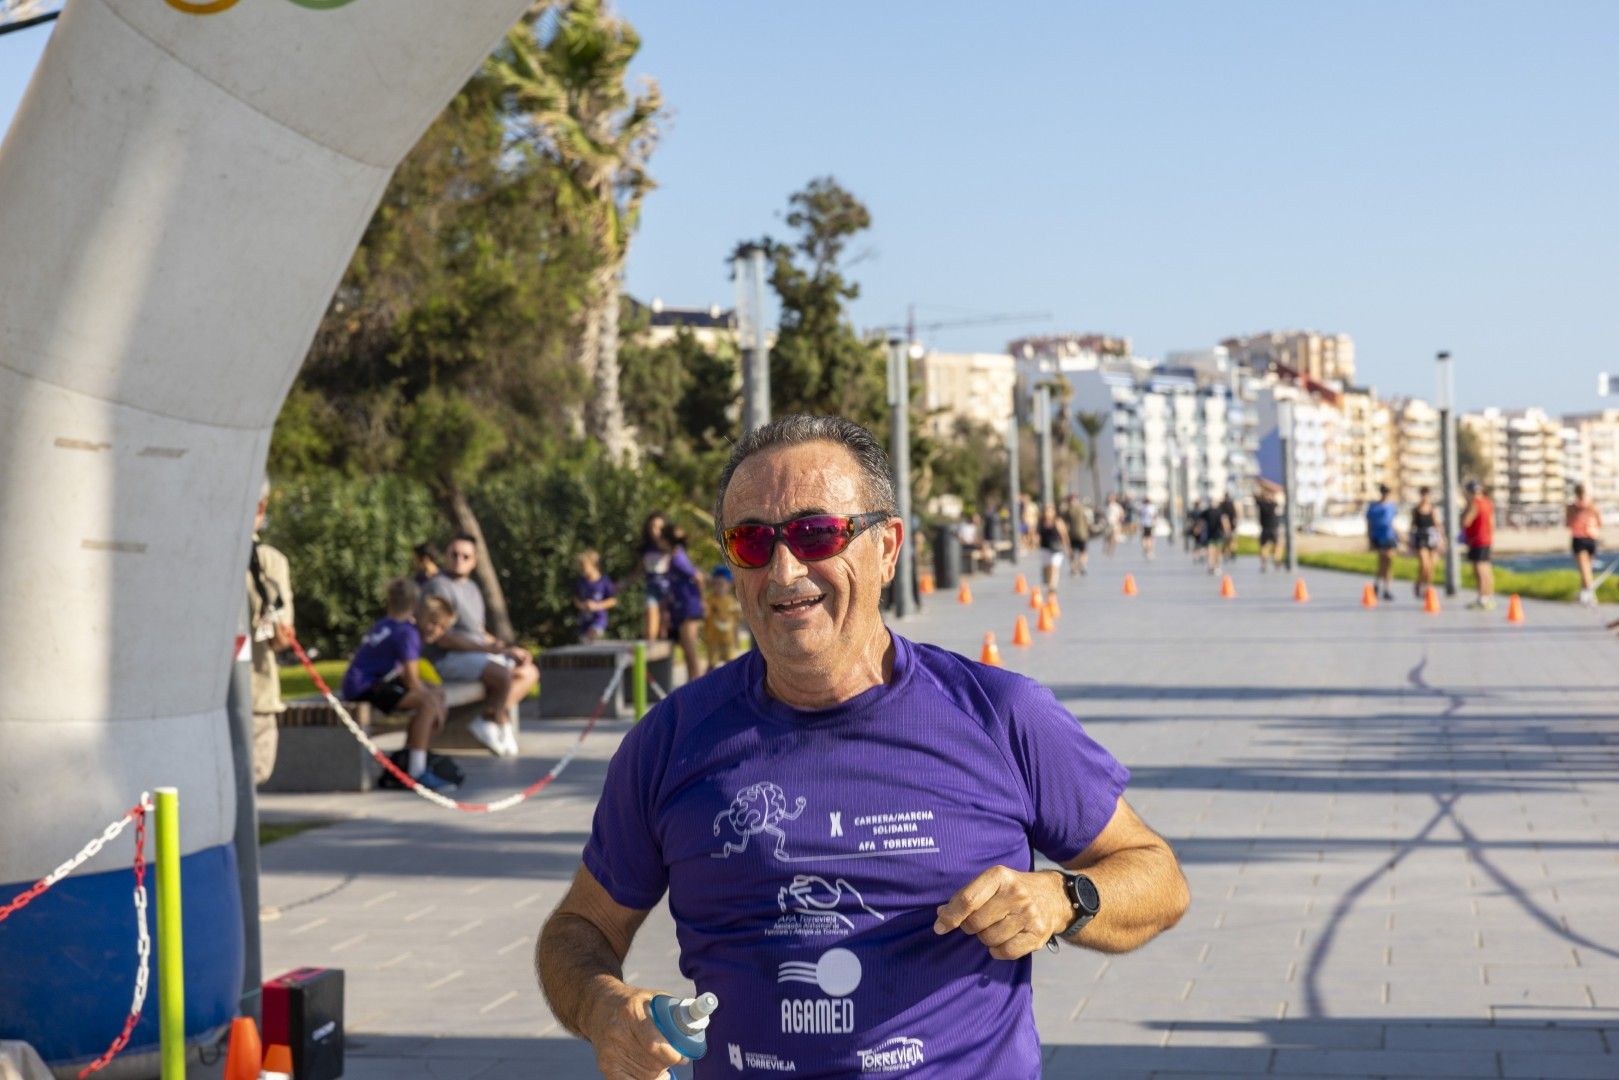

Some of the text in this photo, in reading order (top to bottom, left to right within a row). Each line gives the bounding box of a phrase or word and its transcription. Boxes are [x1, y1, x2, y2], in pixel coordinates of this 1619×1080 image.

[854, 810, 934, 826] CARRERA/MARCHA
[873, 822, 918, 836] SOLIDARIA
[858, 836, 935, 852] AFA TORREVIEJA
[781, 998, 854, 1034] AGAMED
[746, 1058, 796, 1072] TORREVIEJA
